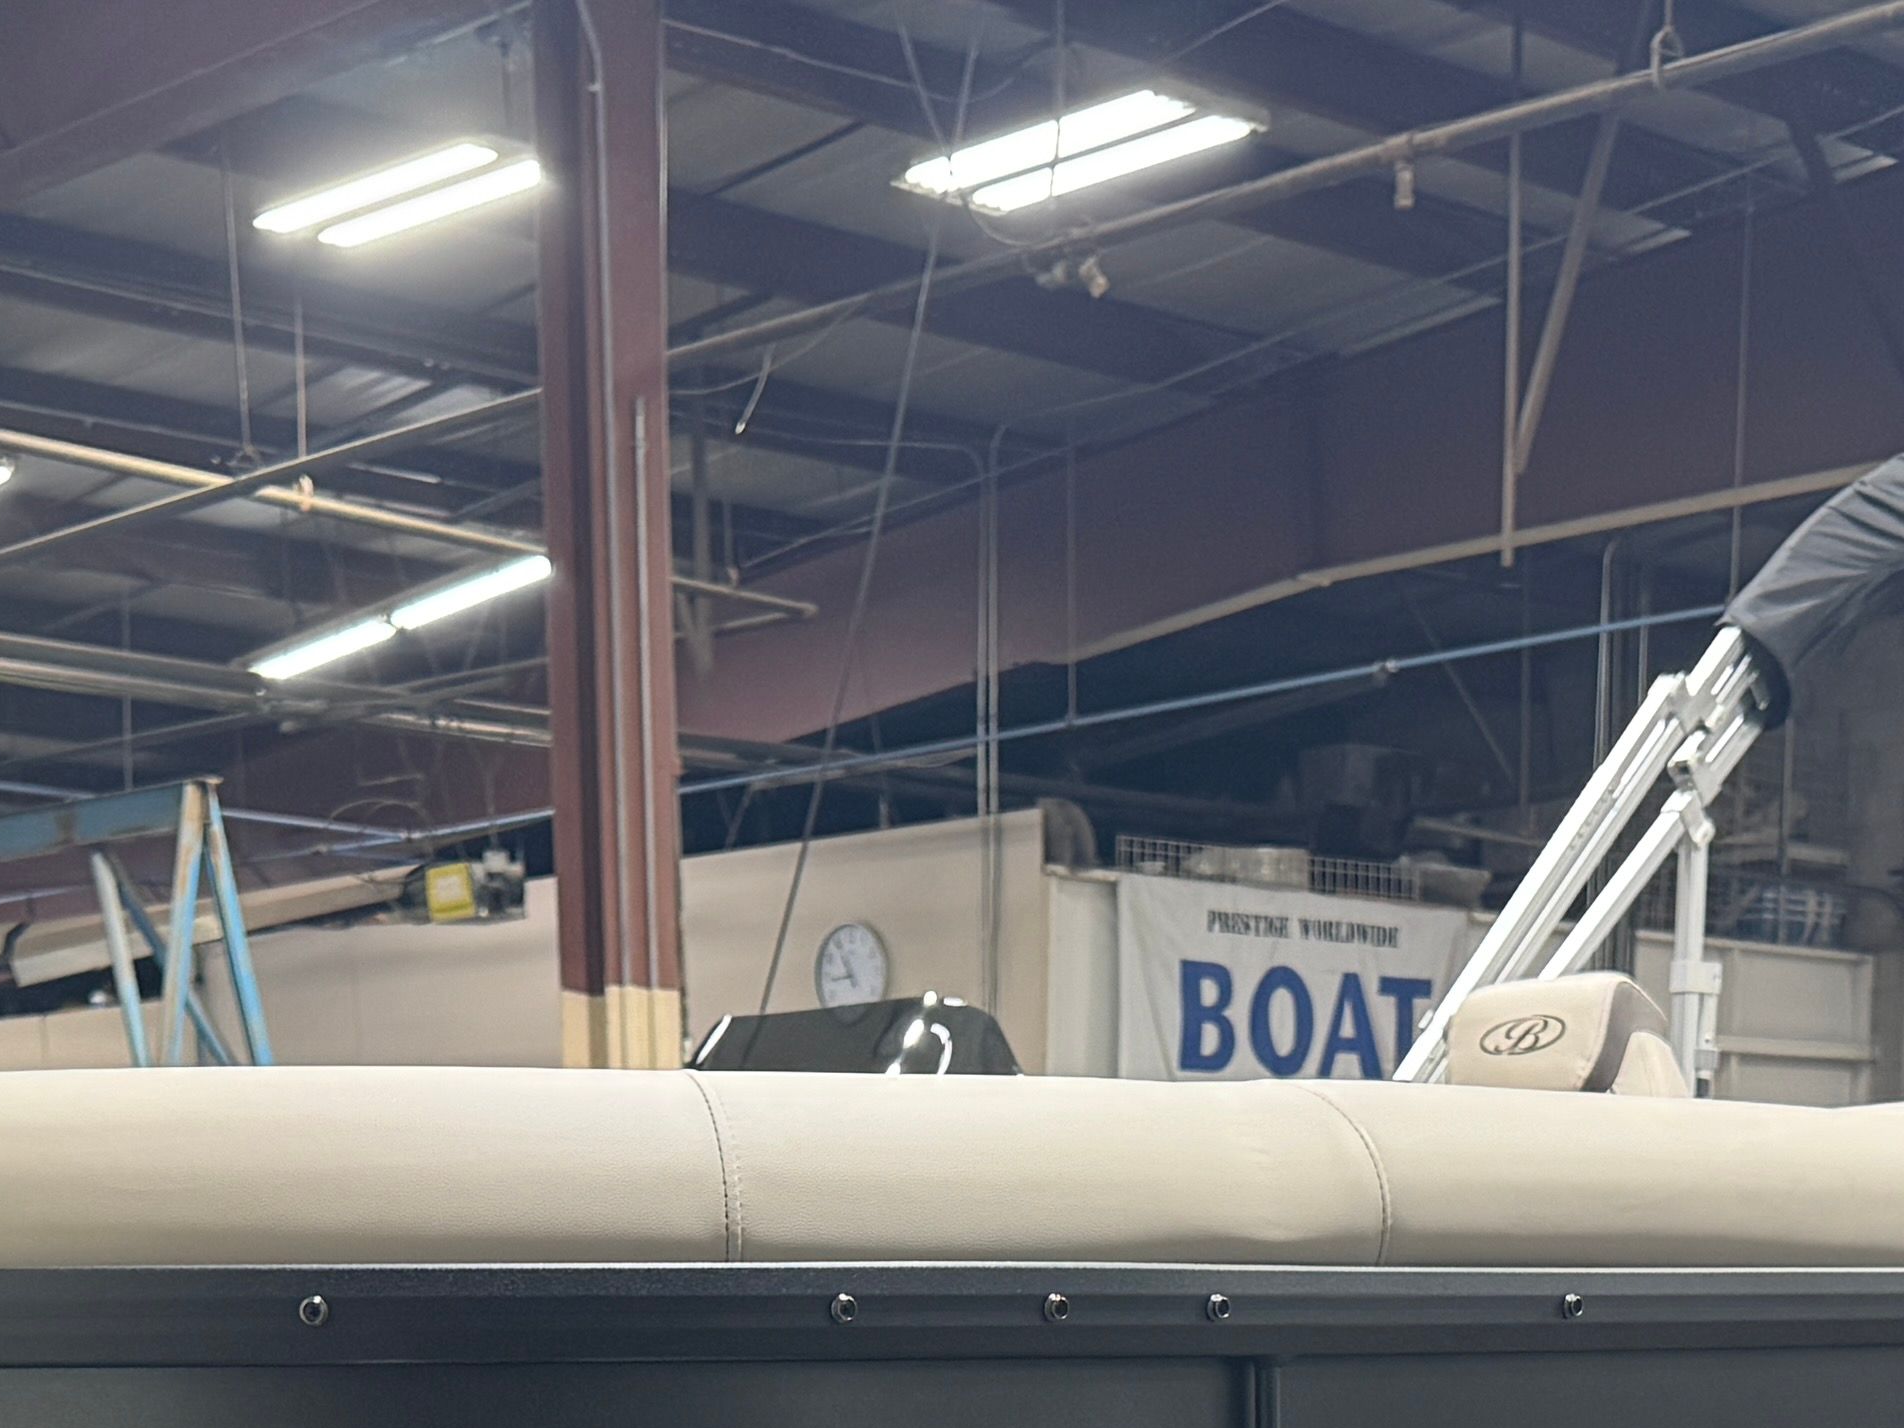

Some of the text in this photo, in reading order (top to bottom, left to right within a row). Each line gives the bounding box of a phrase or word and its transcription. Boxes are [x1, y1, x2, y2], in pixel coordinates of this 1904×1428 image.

[1207, 910, 1399, 948] PRESTIGE WORLDWIDE
[1179, 958, 1432, 1079] BOAT
